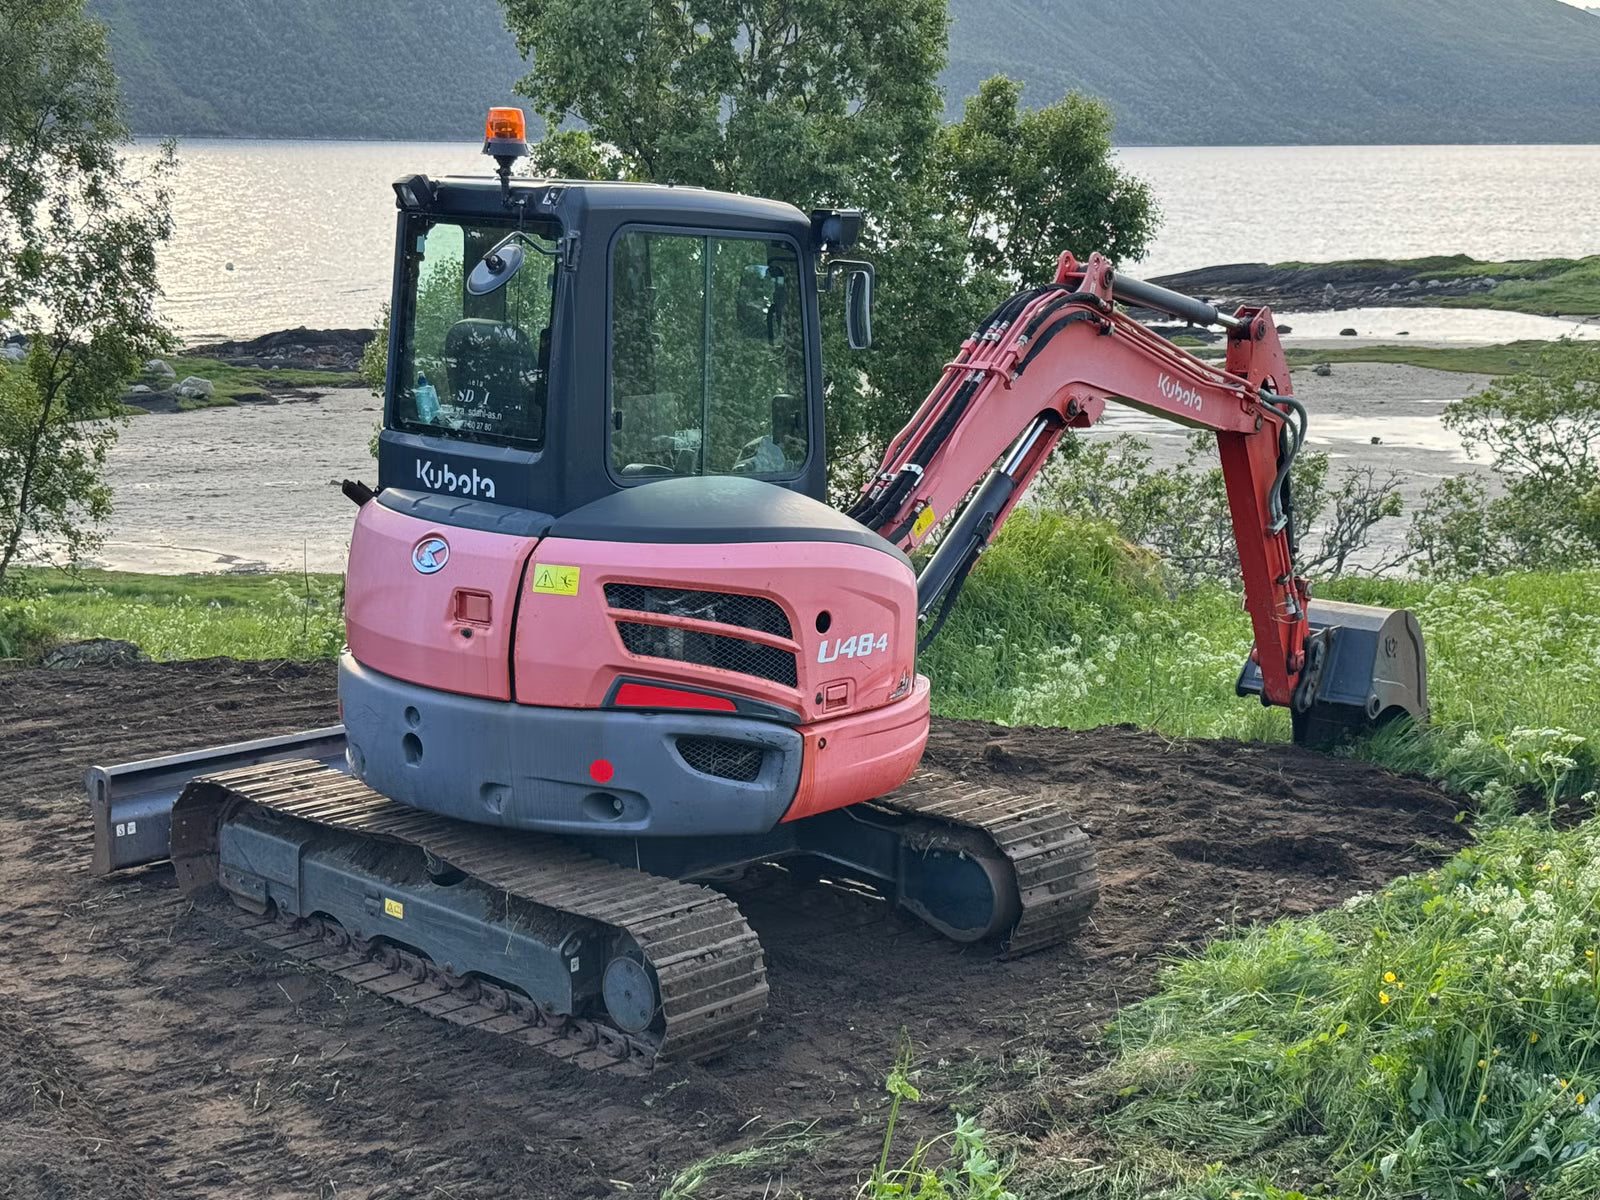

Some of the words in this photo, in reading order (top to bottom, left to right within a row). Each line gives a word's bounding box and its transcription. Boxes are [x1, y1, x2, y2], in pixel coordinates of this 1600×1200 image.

[1158, 373, 1203, 412] Kubota
[416, 459, 496, 498] Kubota
[817, 633, 888, 663] U48-4
